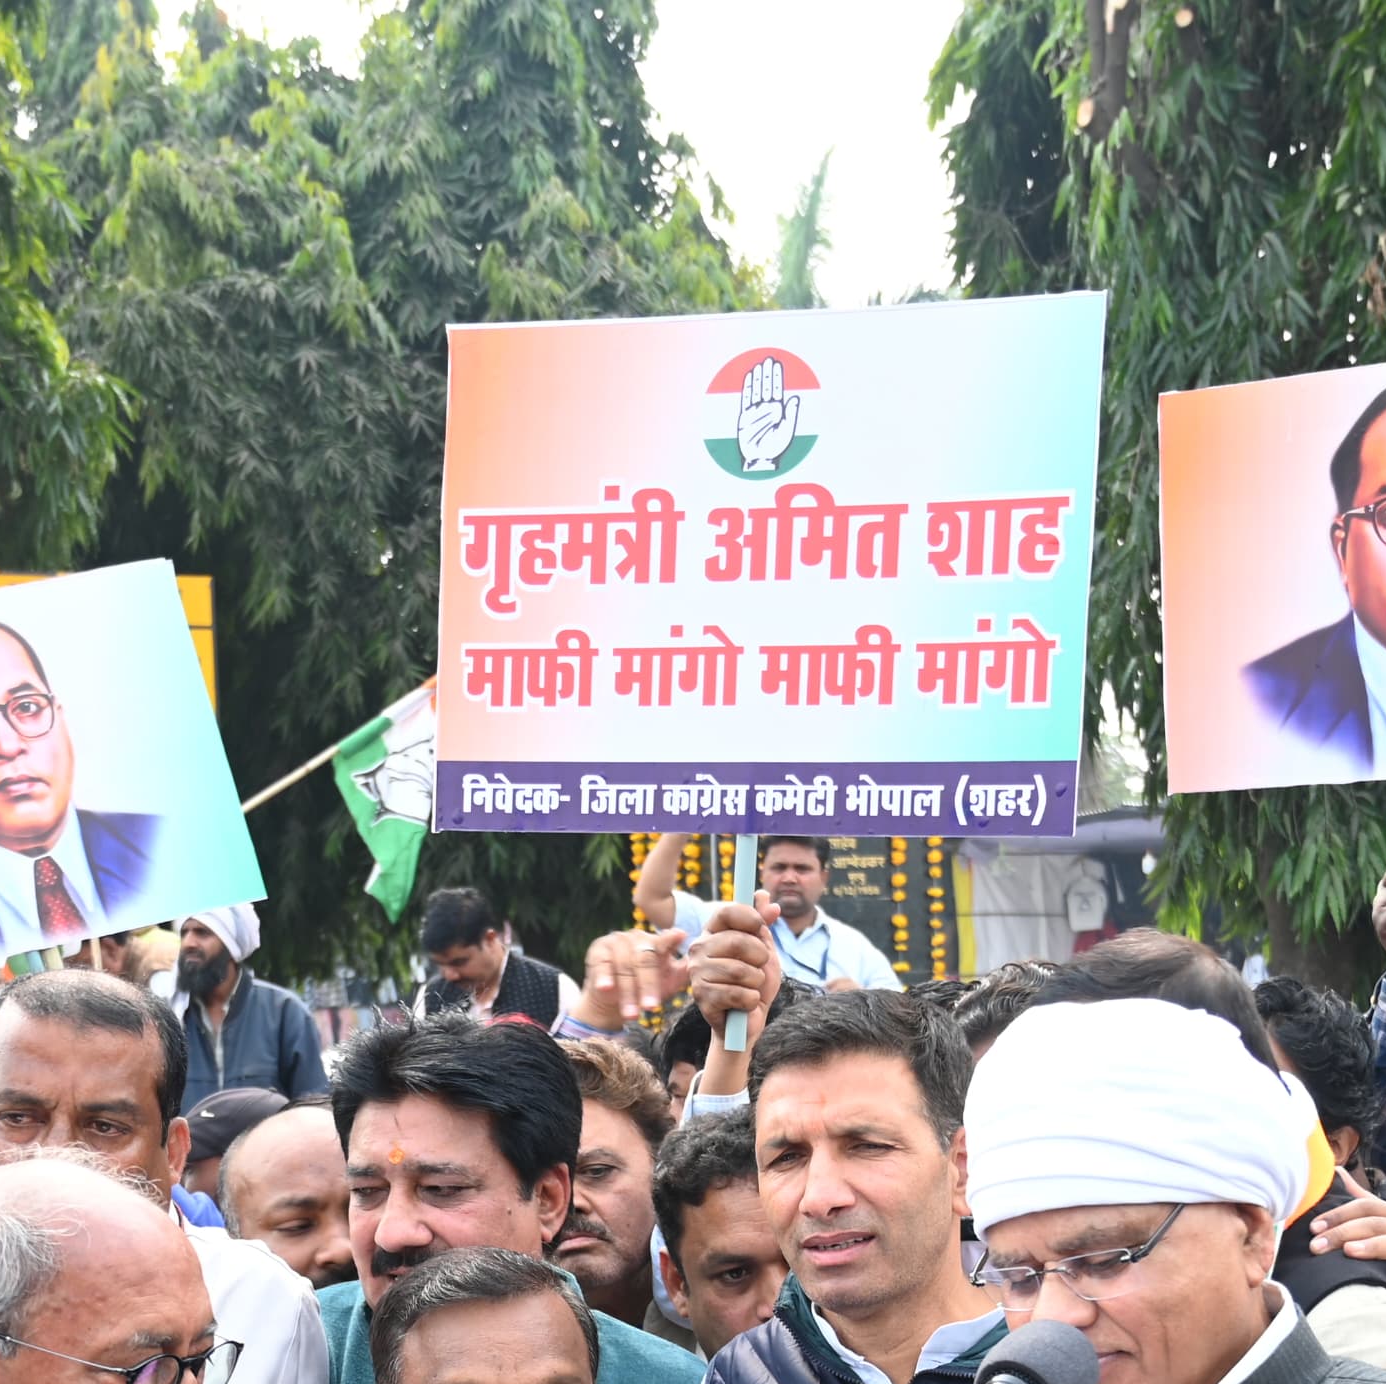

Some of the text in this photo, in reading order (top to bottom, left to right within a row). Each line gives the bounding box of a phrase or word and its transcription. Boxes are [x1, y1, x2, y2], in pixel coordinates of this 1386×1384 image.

[463, 483, 1070, 613] गृहमंत्री अमित शाह
[464, 619, 1056, 706] माफी मांगो माफी मांगो
[462, 773, 1047, 826] निवेदक- जिला कांग्रेस कमेटी भोपाल (शहर)
